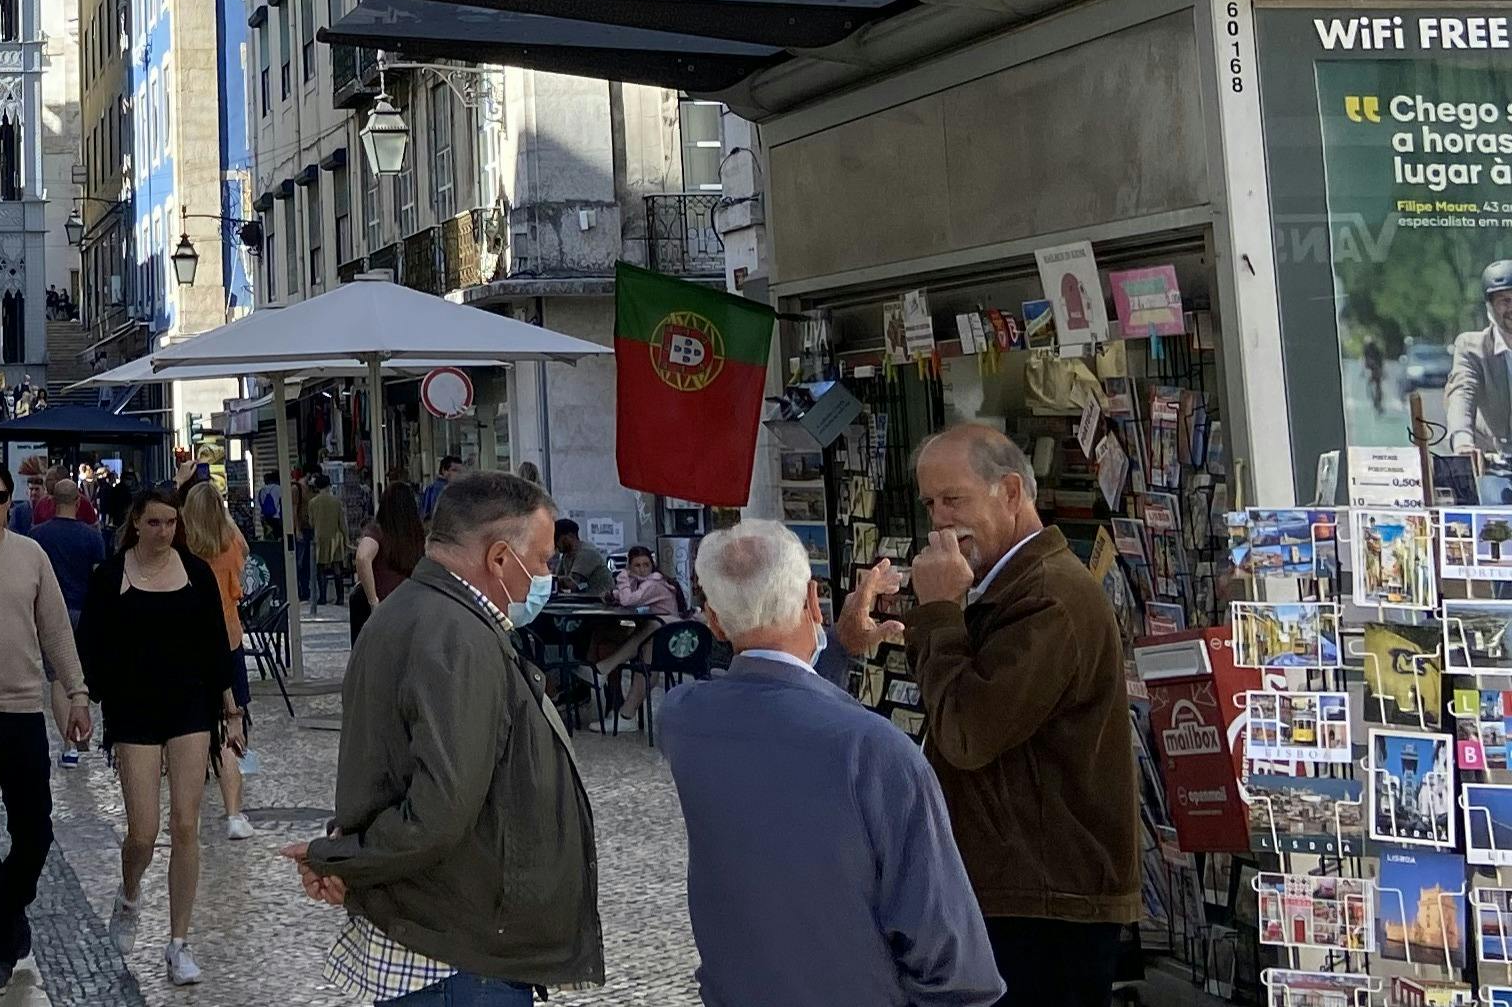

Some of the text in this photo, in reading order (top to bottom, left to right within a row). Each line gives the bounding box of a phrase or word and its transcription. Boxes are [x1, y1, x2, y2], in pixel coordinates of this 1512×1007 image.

[1227, 1, 1243, 93] 60168
[1314, 17, 1510, 50] WiFi FREE
[1389, 94, 1499, 130] Chego
[1392, 126, 1512, 154] a horas
[1393, 156, 1483, 192] lugar
[1397, 199, 1433, 215] Filipe
[1397, 215, 1476, 230] especialista
[1478, 218, 1499, 228] em
[1165, 725, 1219, 752] mailbox
